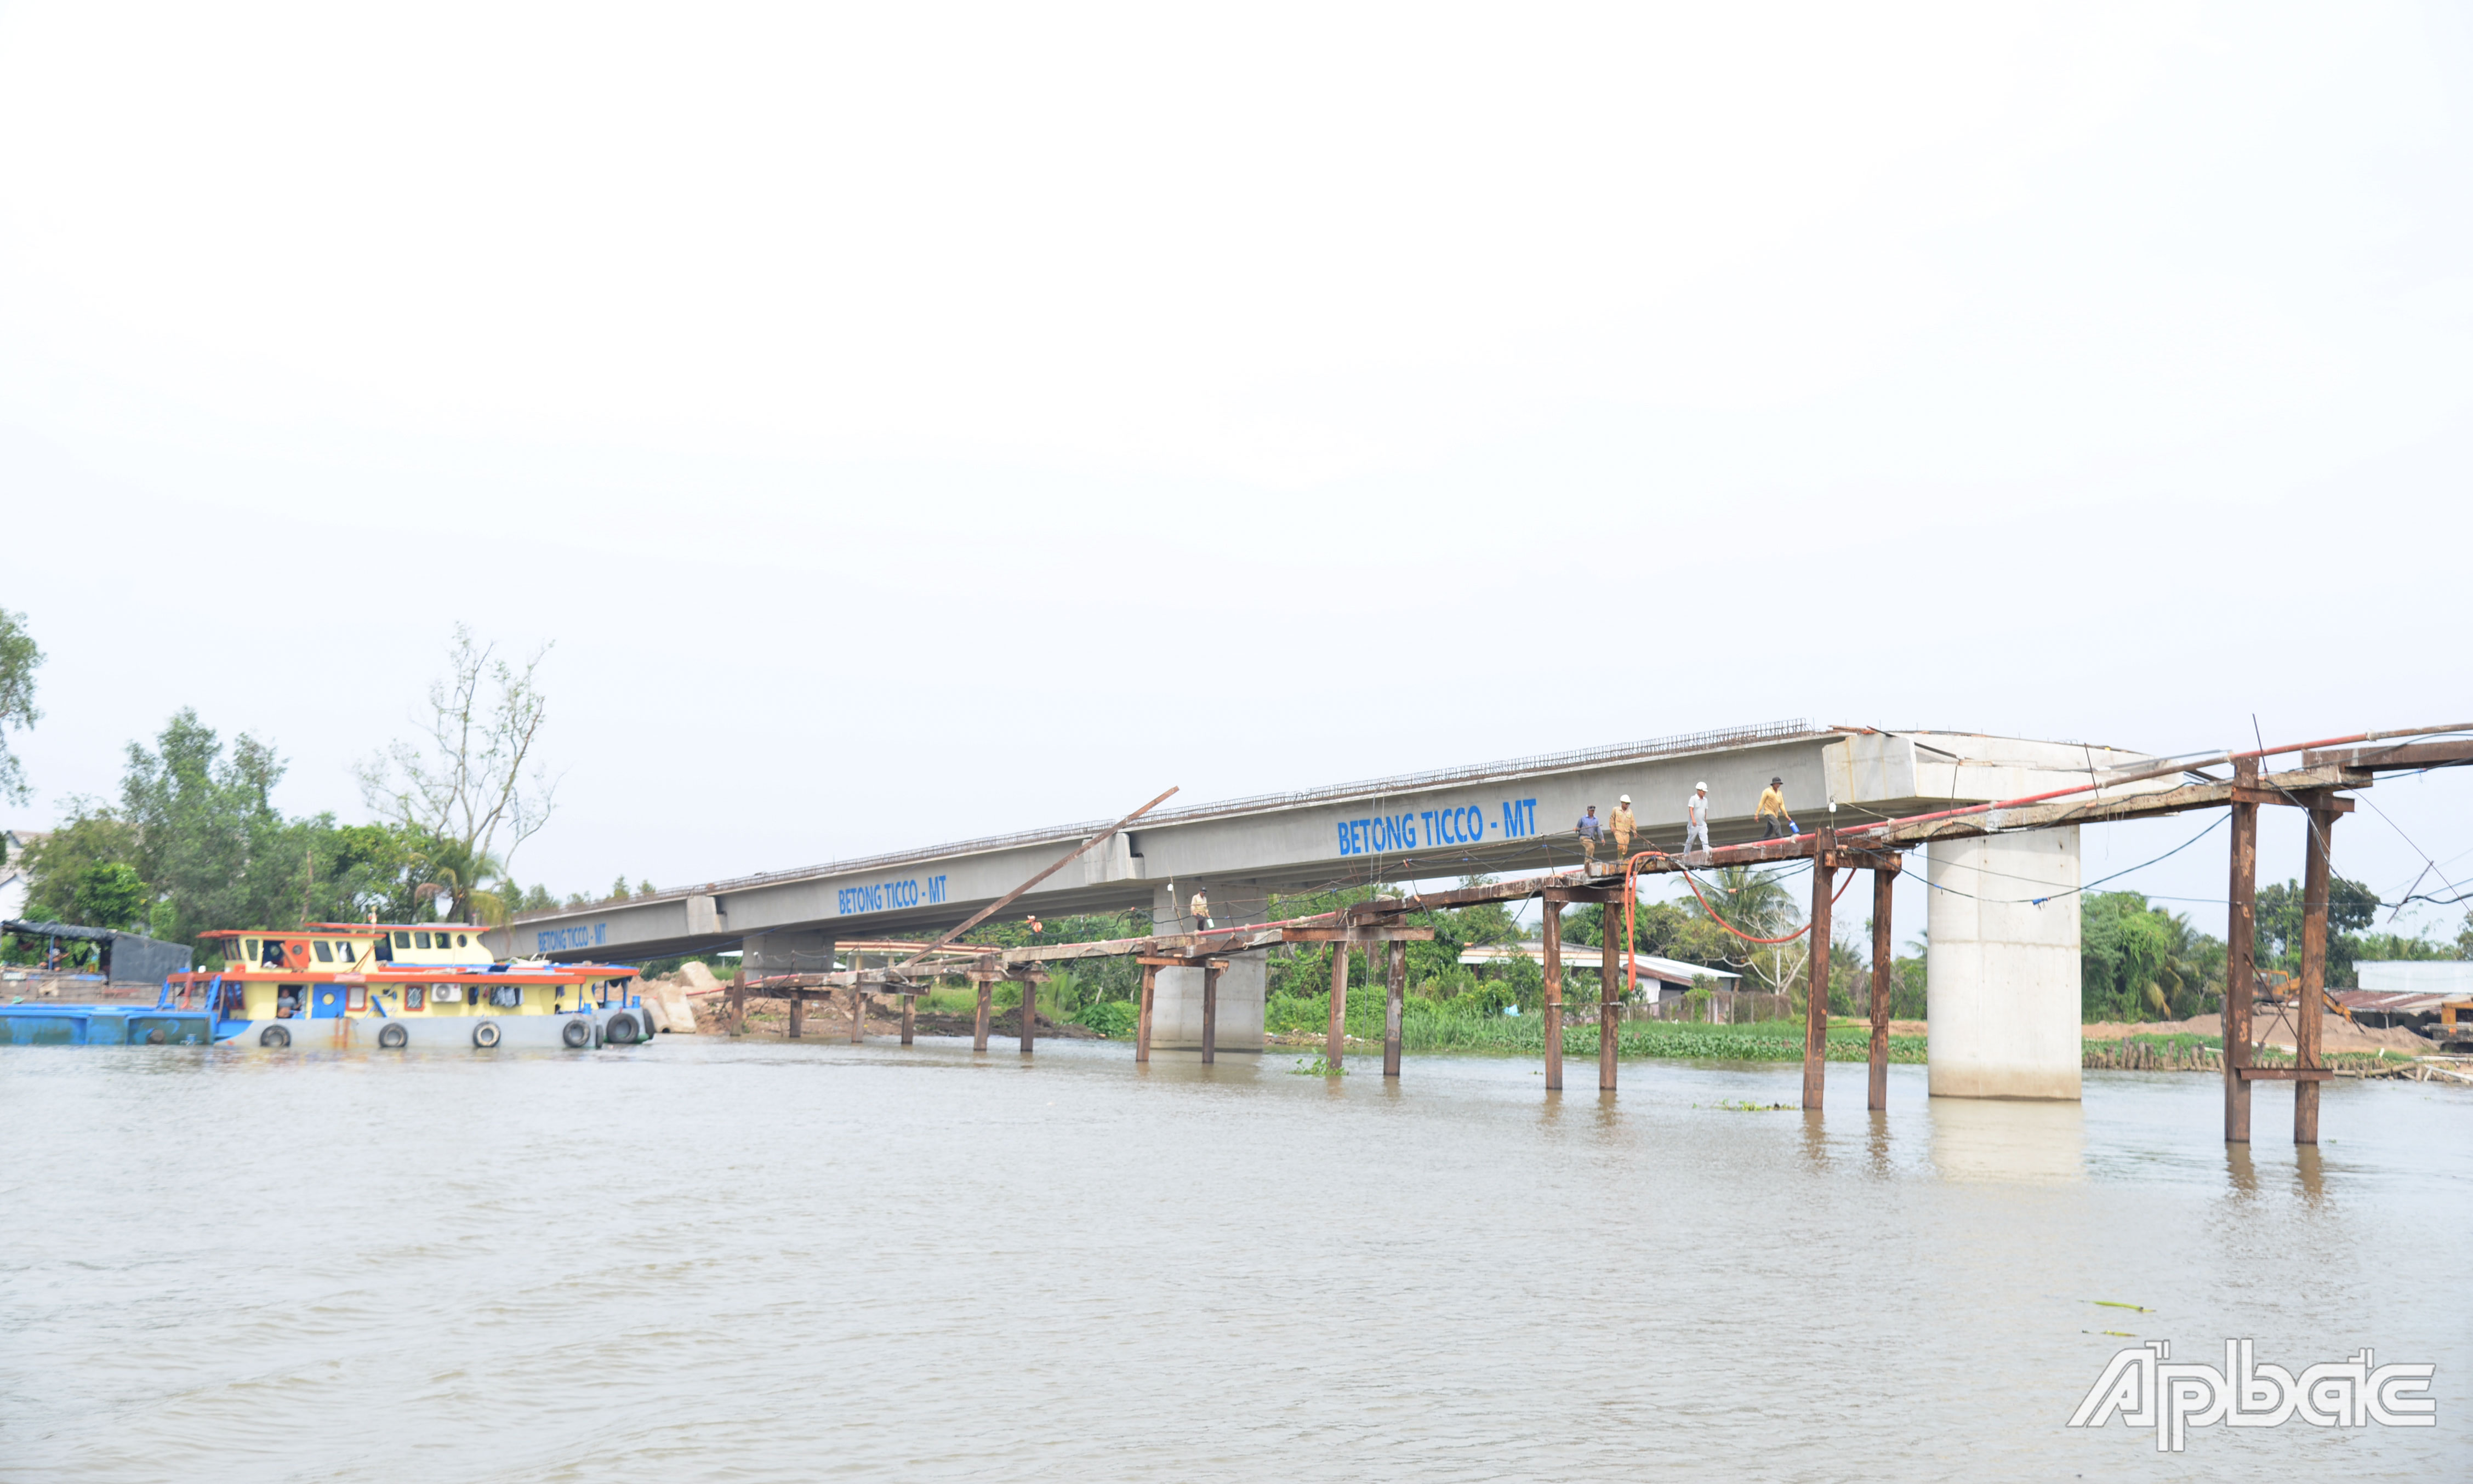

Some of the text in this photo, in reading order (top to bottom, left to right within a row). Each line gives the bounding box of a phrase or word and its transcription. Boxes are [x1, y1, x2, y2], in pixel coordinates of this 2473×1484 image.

[1338, 813, 1416, 855] BETONG
[1421, 806, 1483, 846] TICCO
[1503, 798, 1537, 837] MT
[839, 884, 882, 915] BETONG
[884, 880, 919, 909] TICCO
[928, 875, 947, 903] MT
[538, 929, 566, 952] BETONG
[567, 926, 589, 947] TICCO
[595, 923, 607, 945] MT
